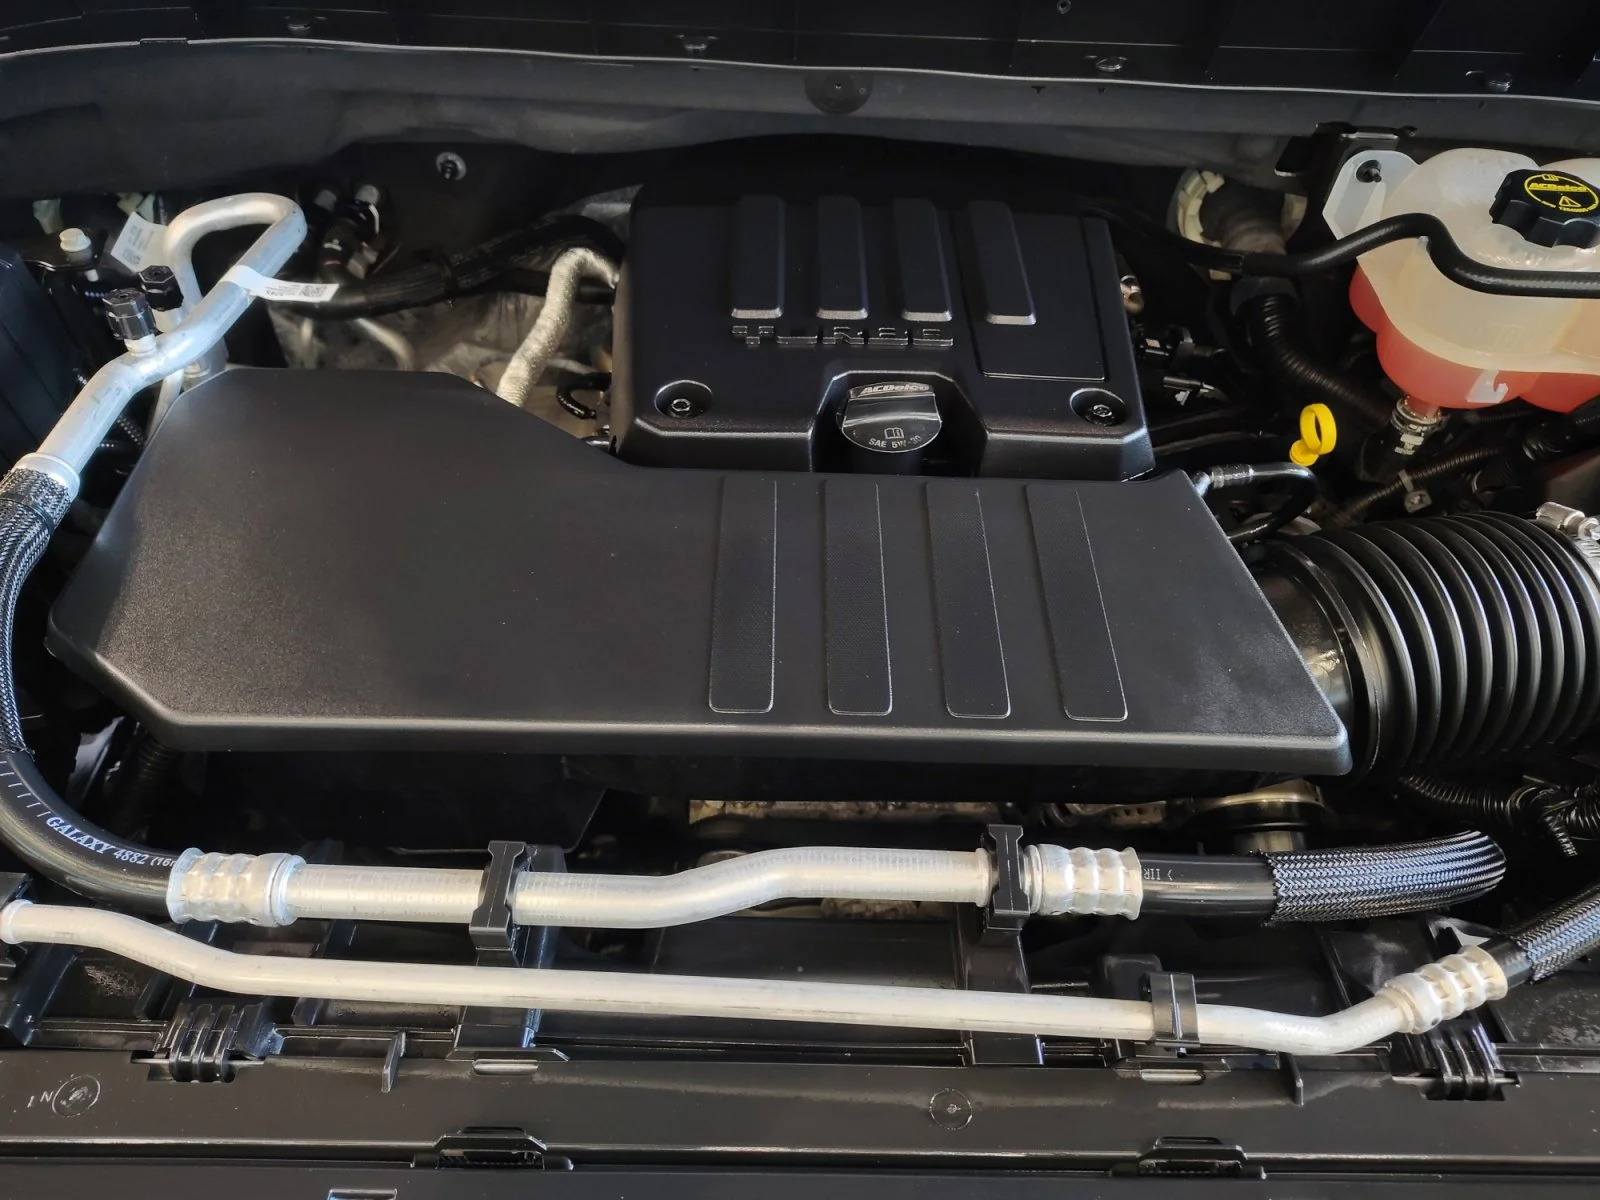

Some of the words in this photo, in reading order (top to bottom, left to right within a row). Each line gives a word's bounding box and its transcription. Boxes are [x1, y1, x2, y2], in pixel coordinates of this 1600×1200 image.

[860, 384, 930, 395] ACDelco
[868, 438, 887, 448] SAE
[891, 435, 921, 449] 5W-30
[46, 816, 117, 854] GALAXY
[113, 849, 149, 865] 4882
